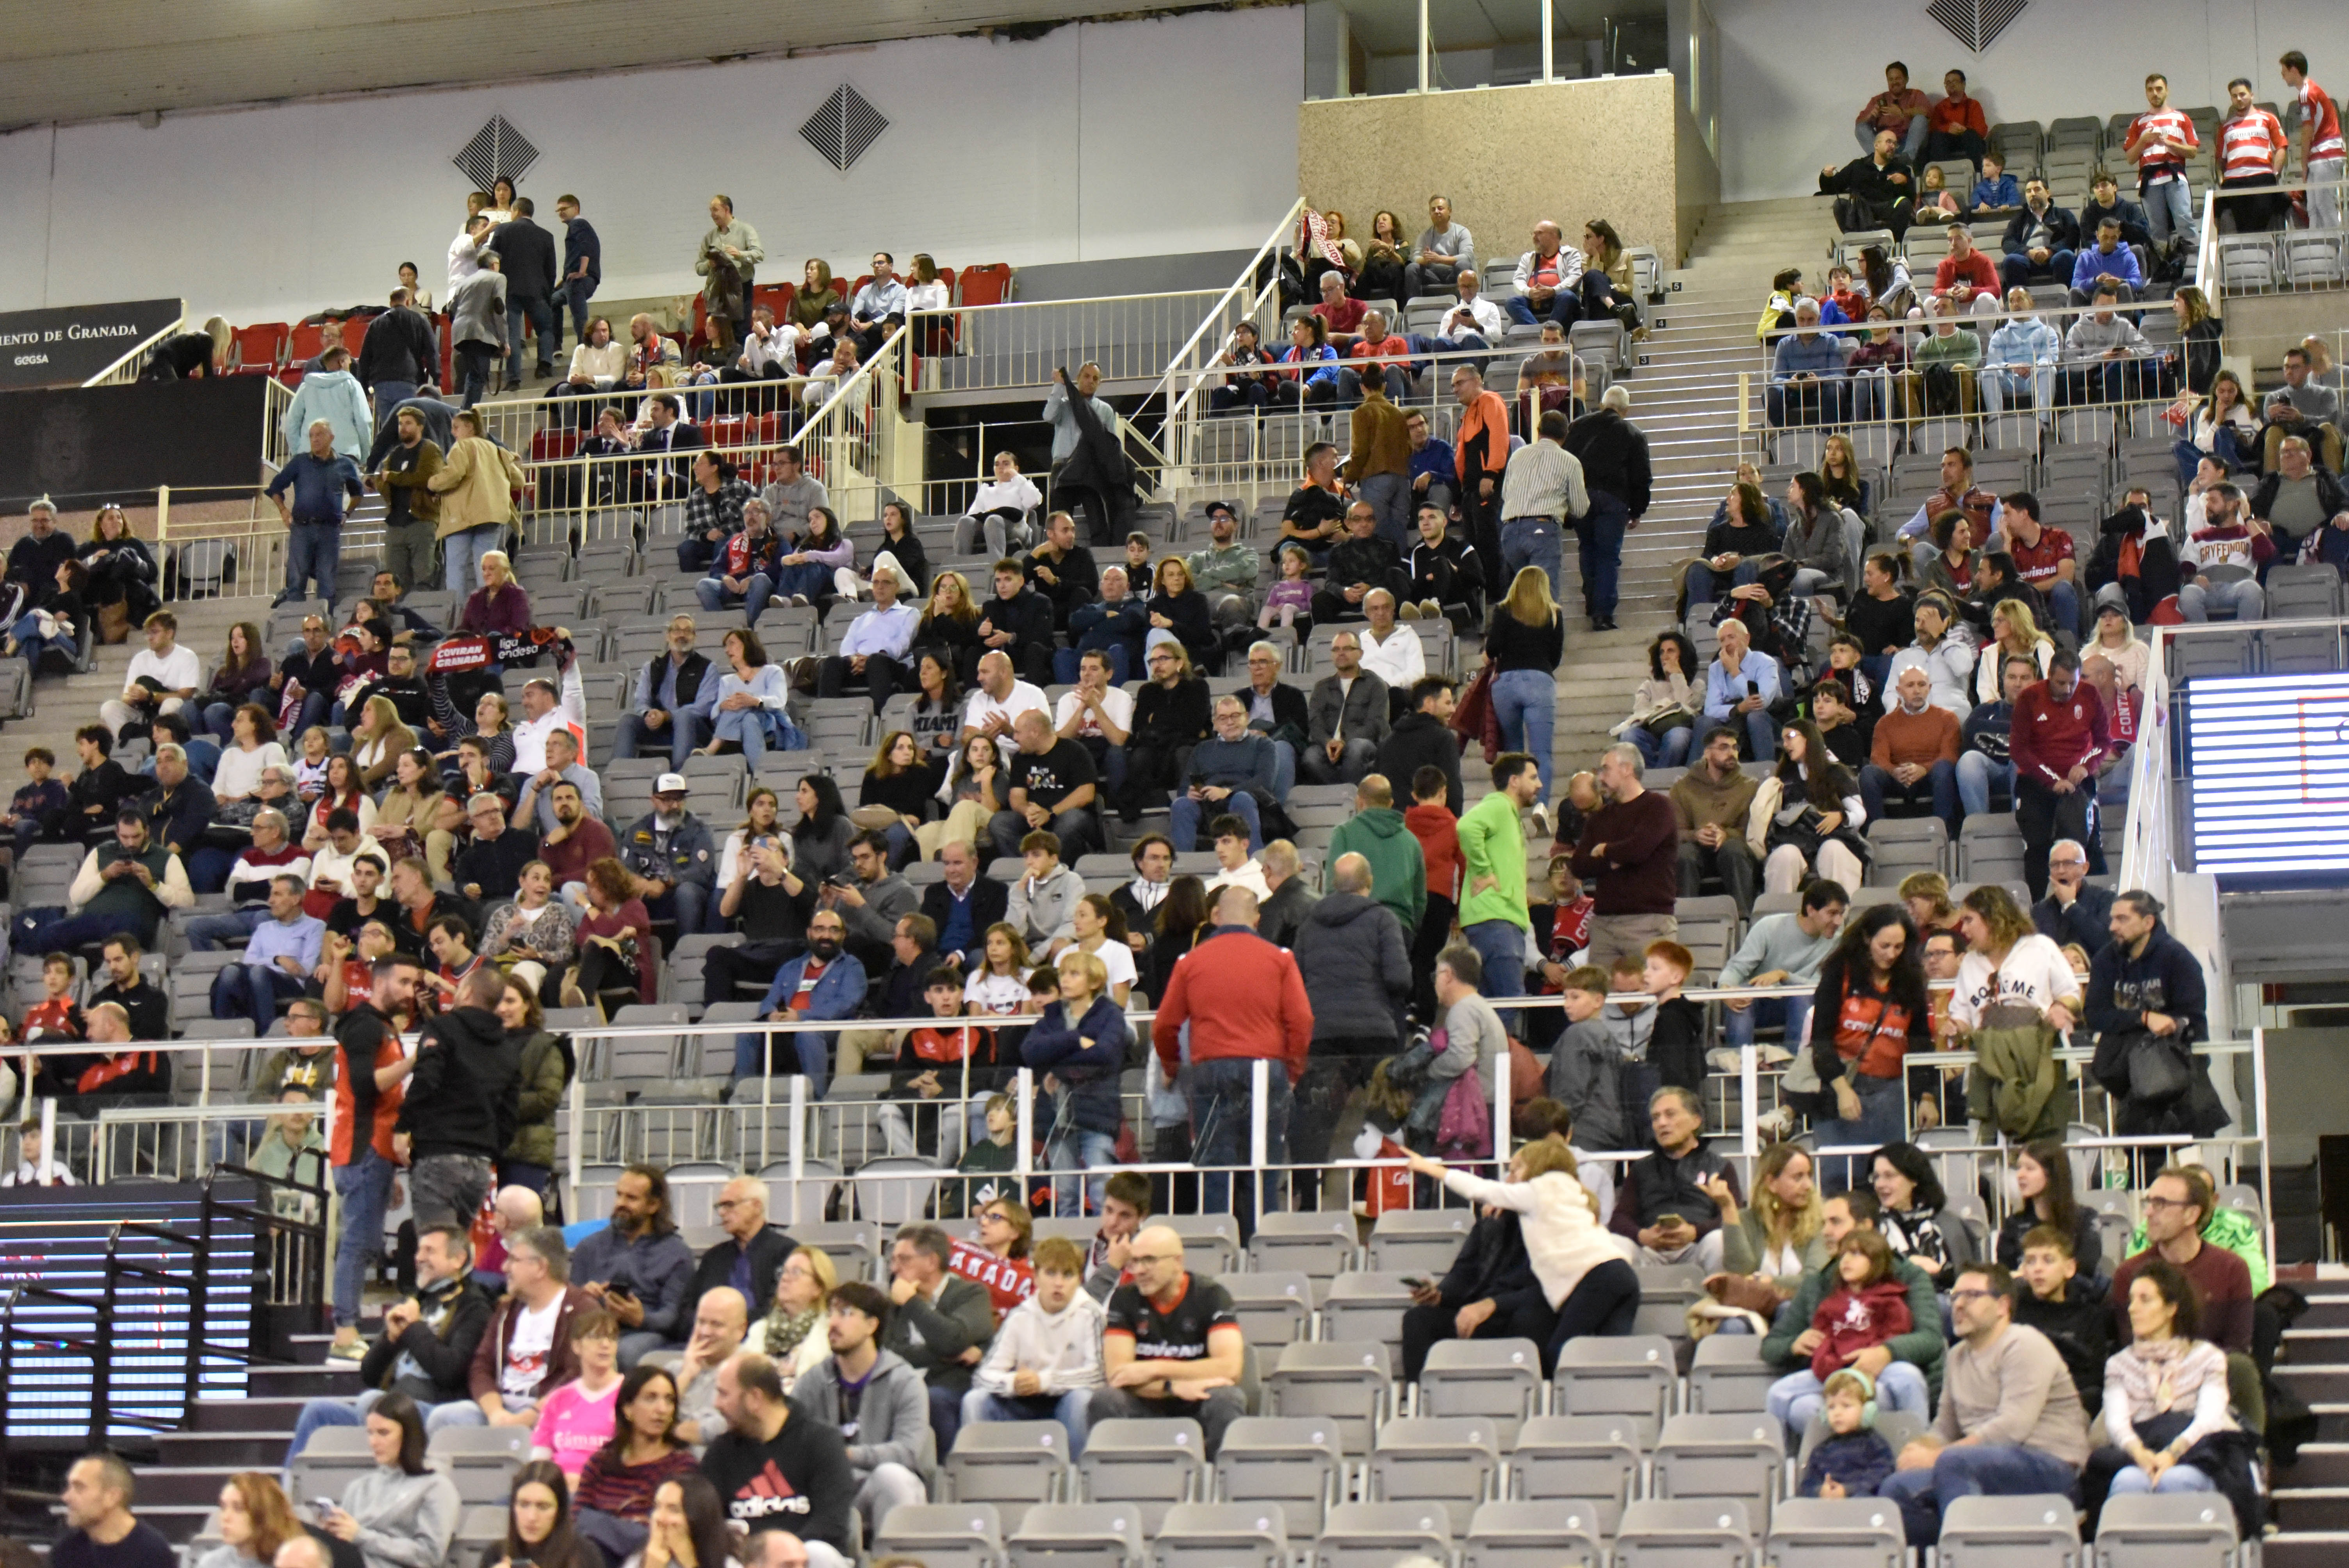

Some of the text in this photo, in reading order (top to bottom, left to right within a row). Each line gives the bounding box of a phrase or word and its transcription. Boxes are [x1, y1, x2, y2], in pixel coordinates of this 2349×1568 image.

[499, 638, 519, 649] liga
[437, 645, 483, 658] COVIRAN
[498, 645, 538, 659] endesa
[436, 653, 486, 668] GRANADA
[914, 715, 958, 732] MIAMI
